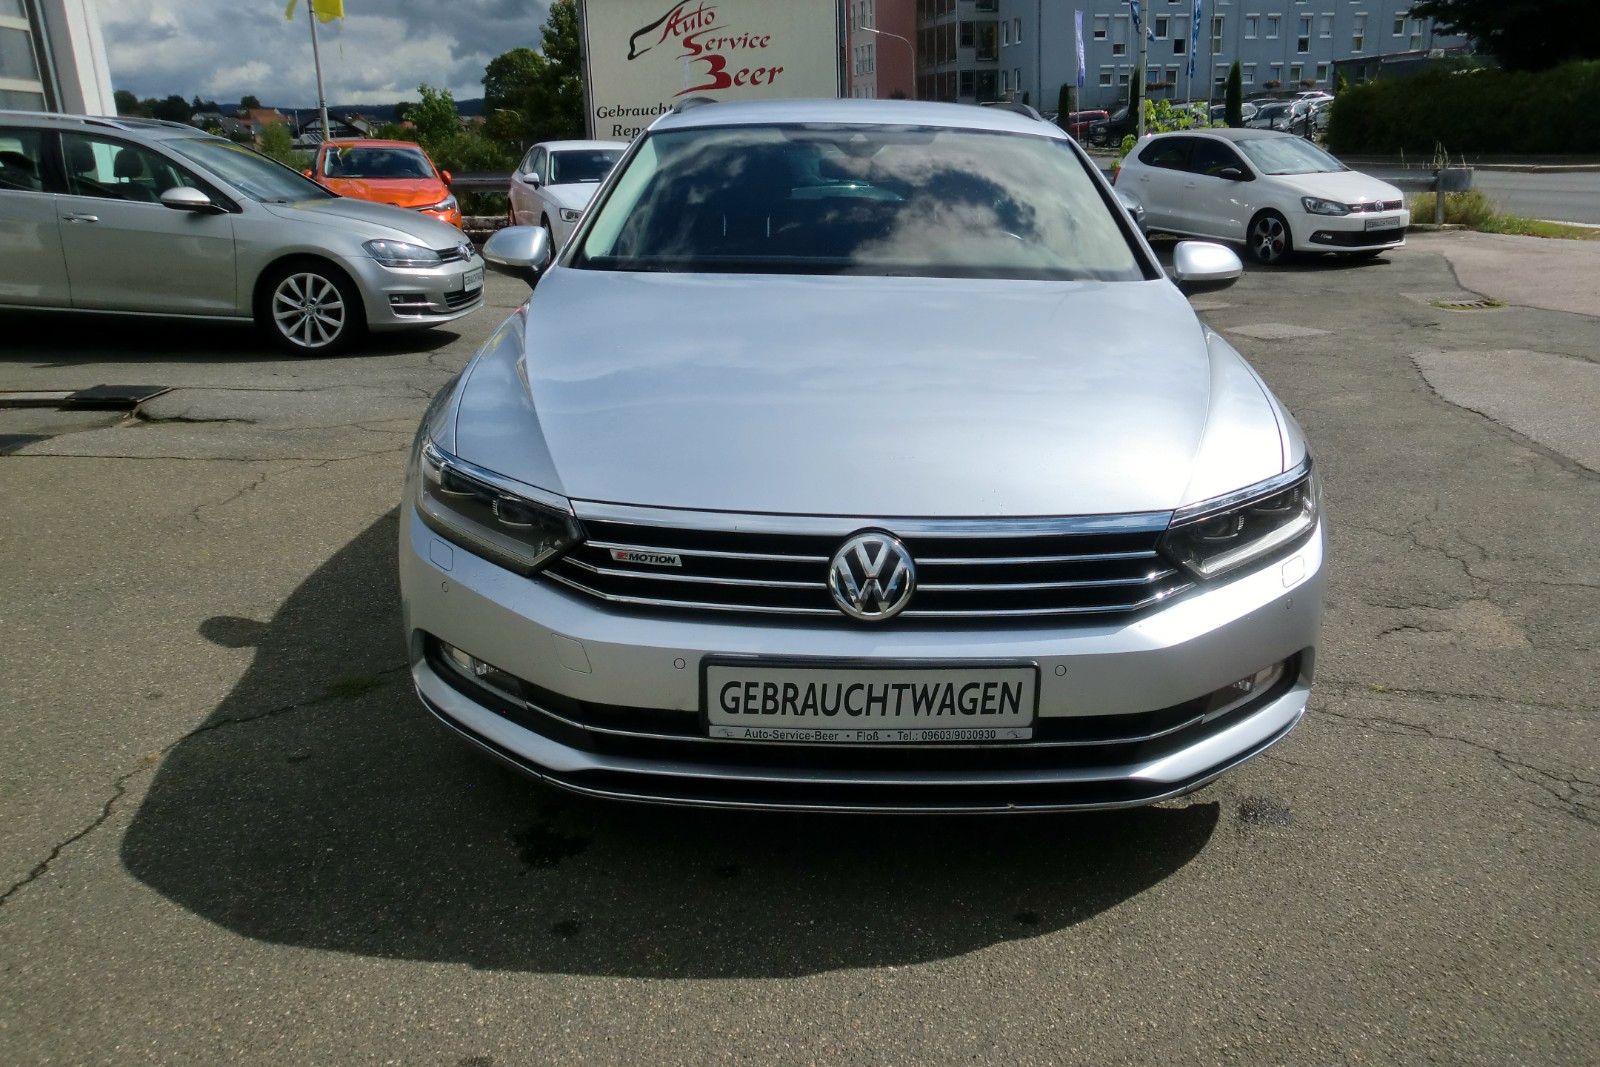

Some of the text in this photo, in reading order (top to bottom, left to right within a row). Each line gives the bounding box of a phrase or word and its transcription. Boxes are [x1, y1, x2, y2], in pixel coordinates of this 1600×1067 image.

[657, 2, 718, 45] Auto
[676, 25, 770, 60] Service
[672, 54, 783, 97] Beer
[612, 124, 645, 138] Rep
[834, 536, 908, 617] VW
[719, 681, 1023, 717] GEBRAUCHTWAGEN
[744, 728, 996, 741] Auto-Service-Beer Floß Tel.: 09603/9030930
